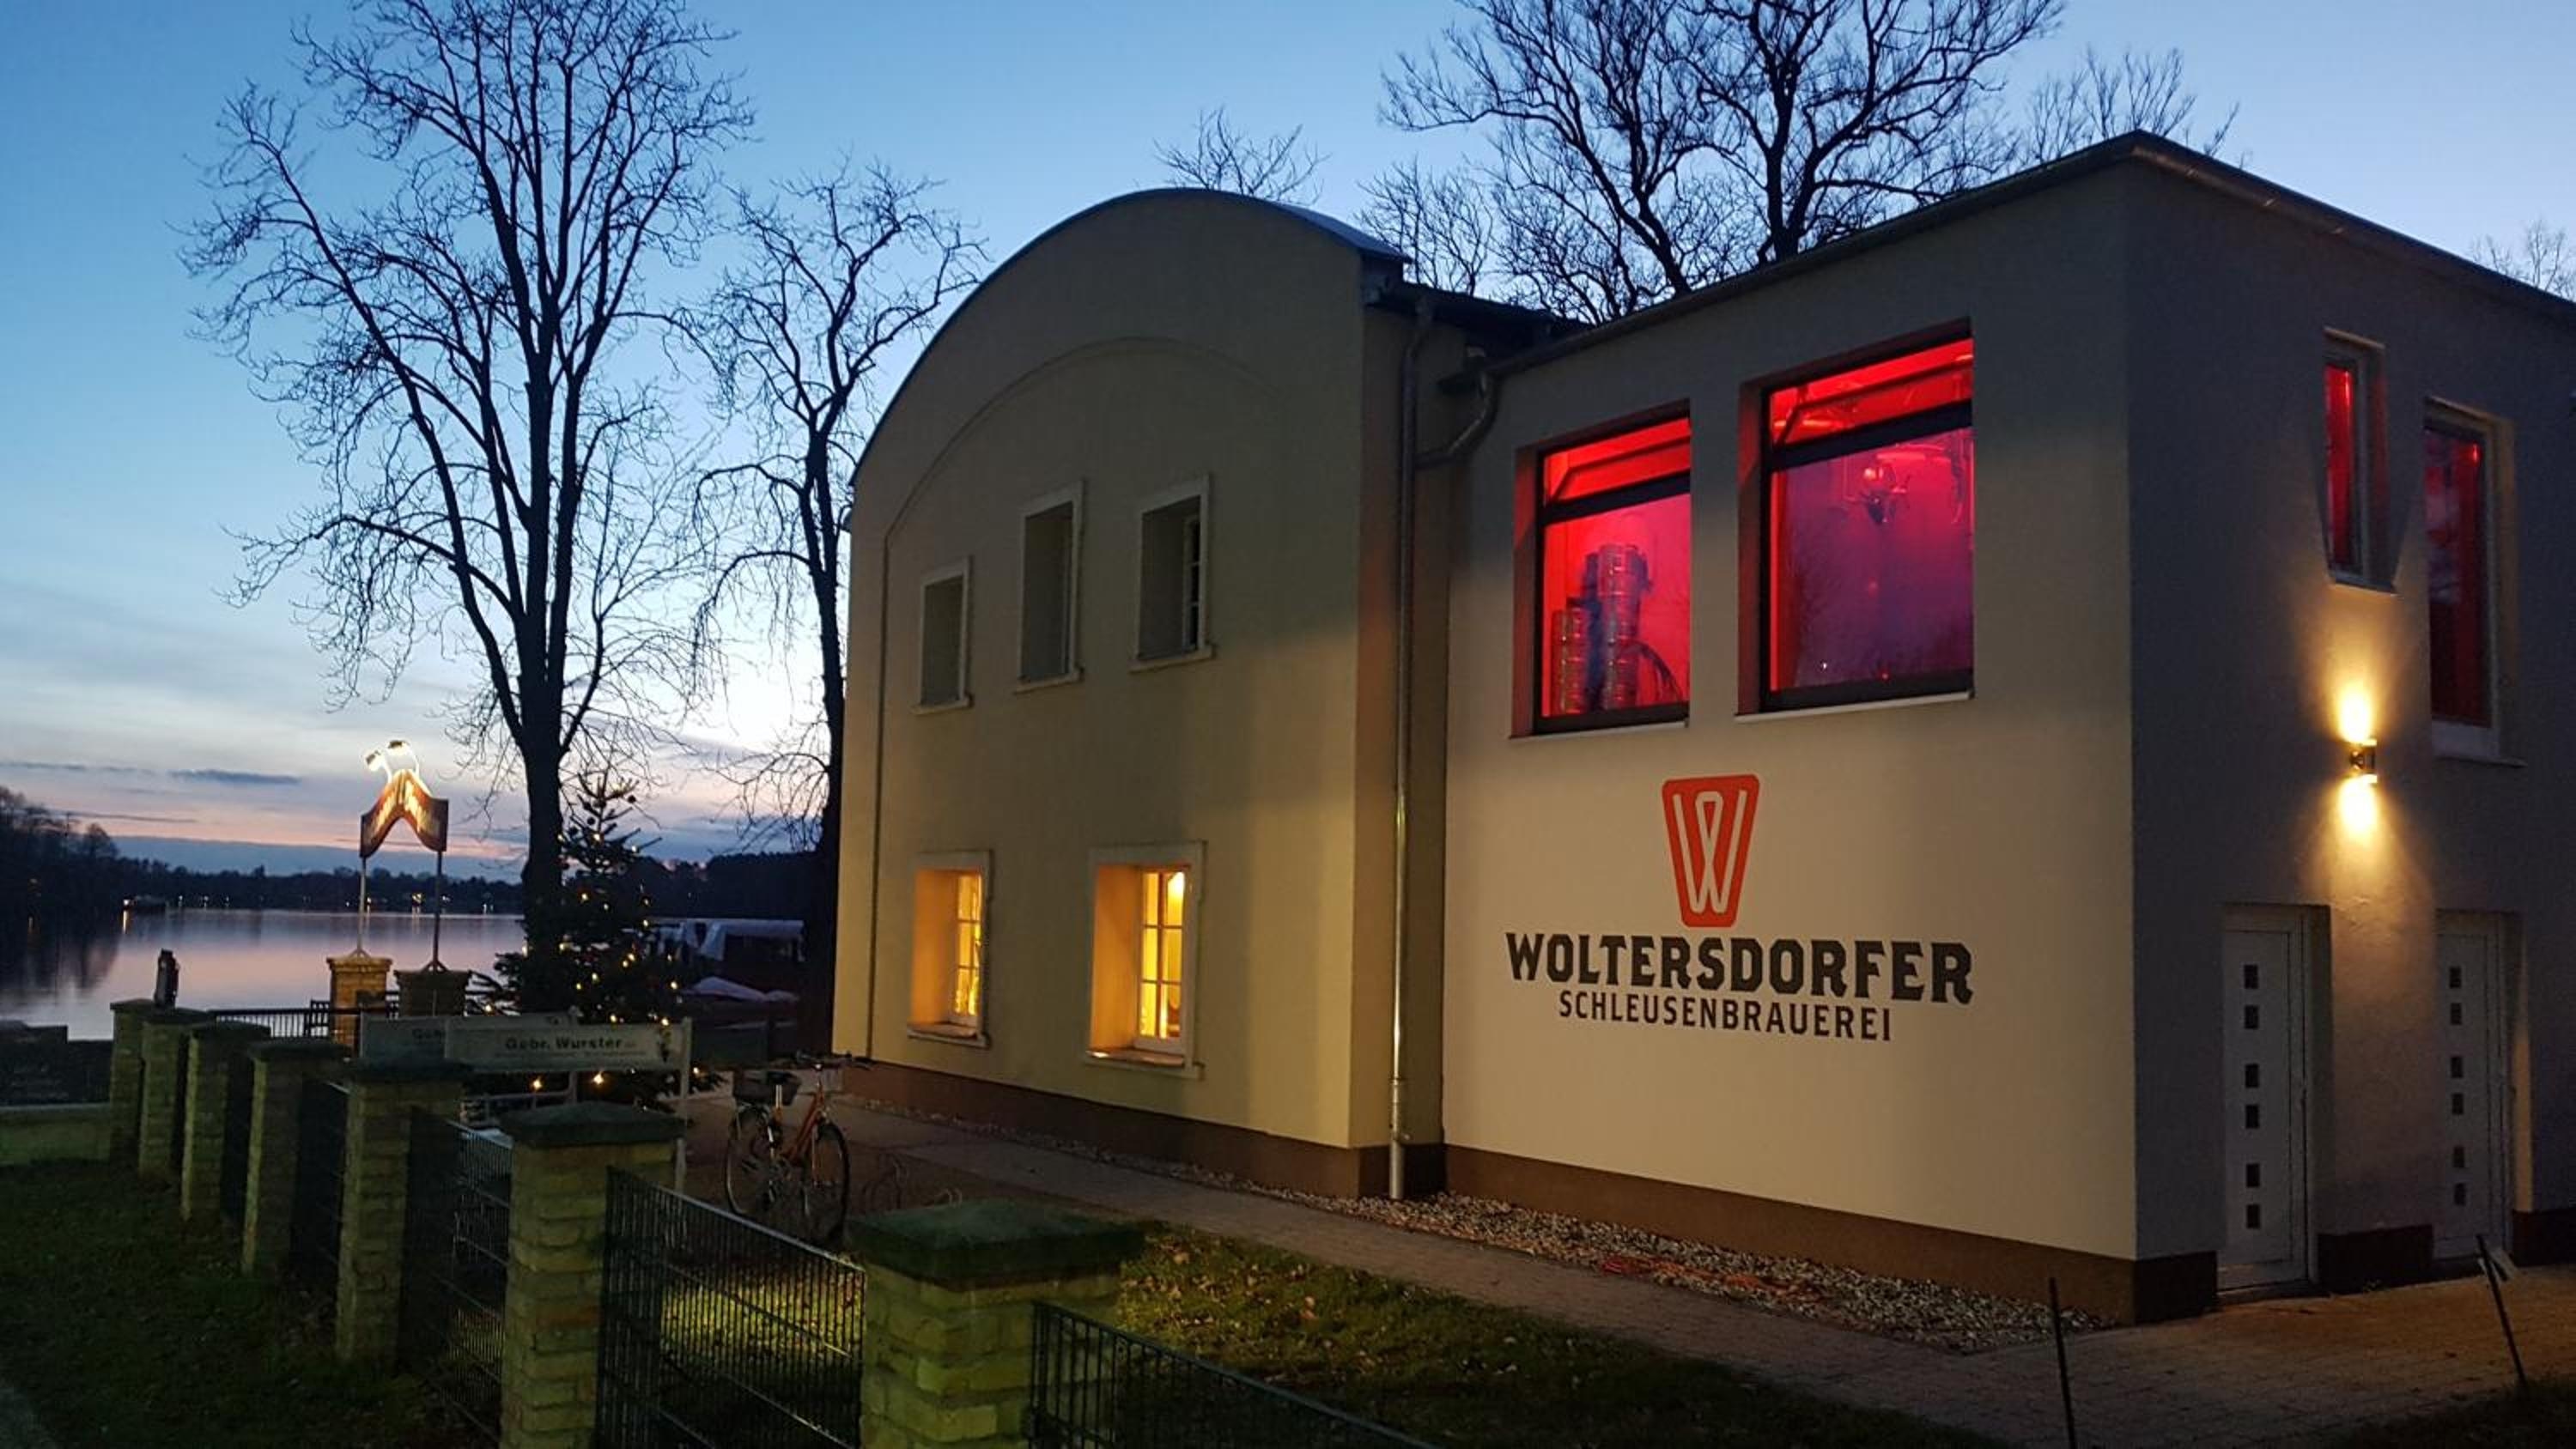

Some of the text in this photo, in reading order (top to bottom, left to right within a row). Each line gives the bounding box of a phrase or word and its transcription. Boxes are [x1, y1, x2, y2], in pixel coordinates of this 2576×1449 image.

[1672, 789, 1748, 914] W
[1505, 931, 1973, 1004] WOLTERSDORFER
[556, 1036, 623, 1050] Wurster
[1559, 990, 1891, 1041] SCHLEUSENBRAUEREI
